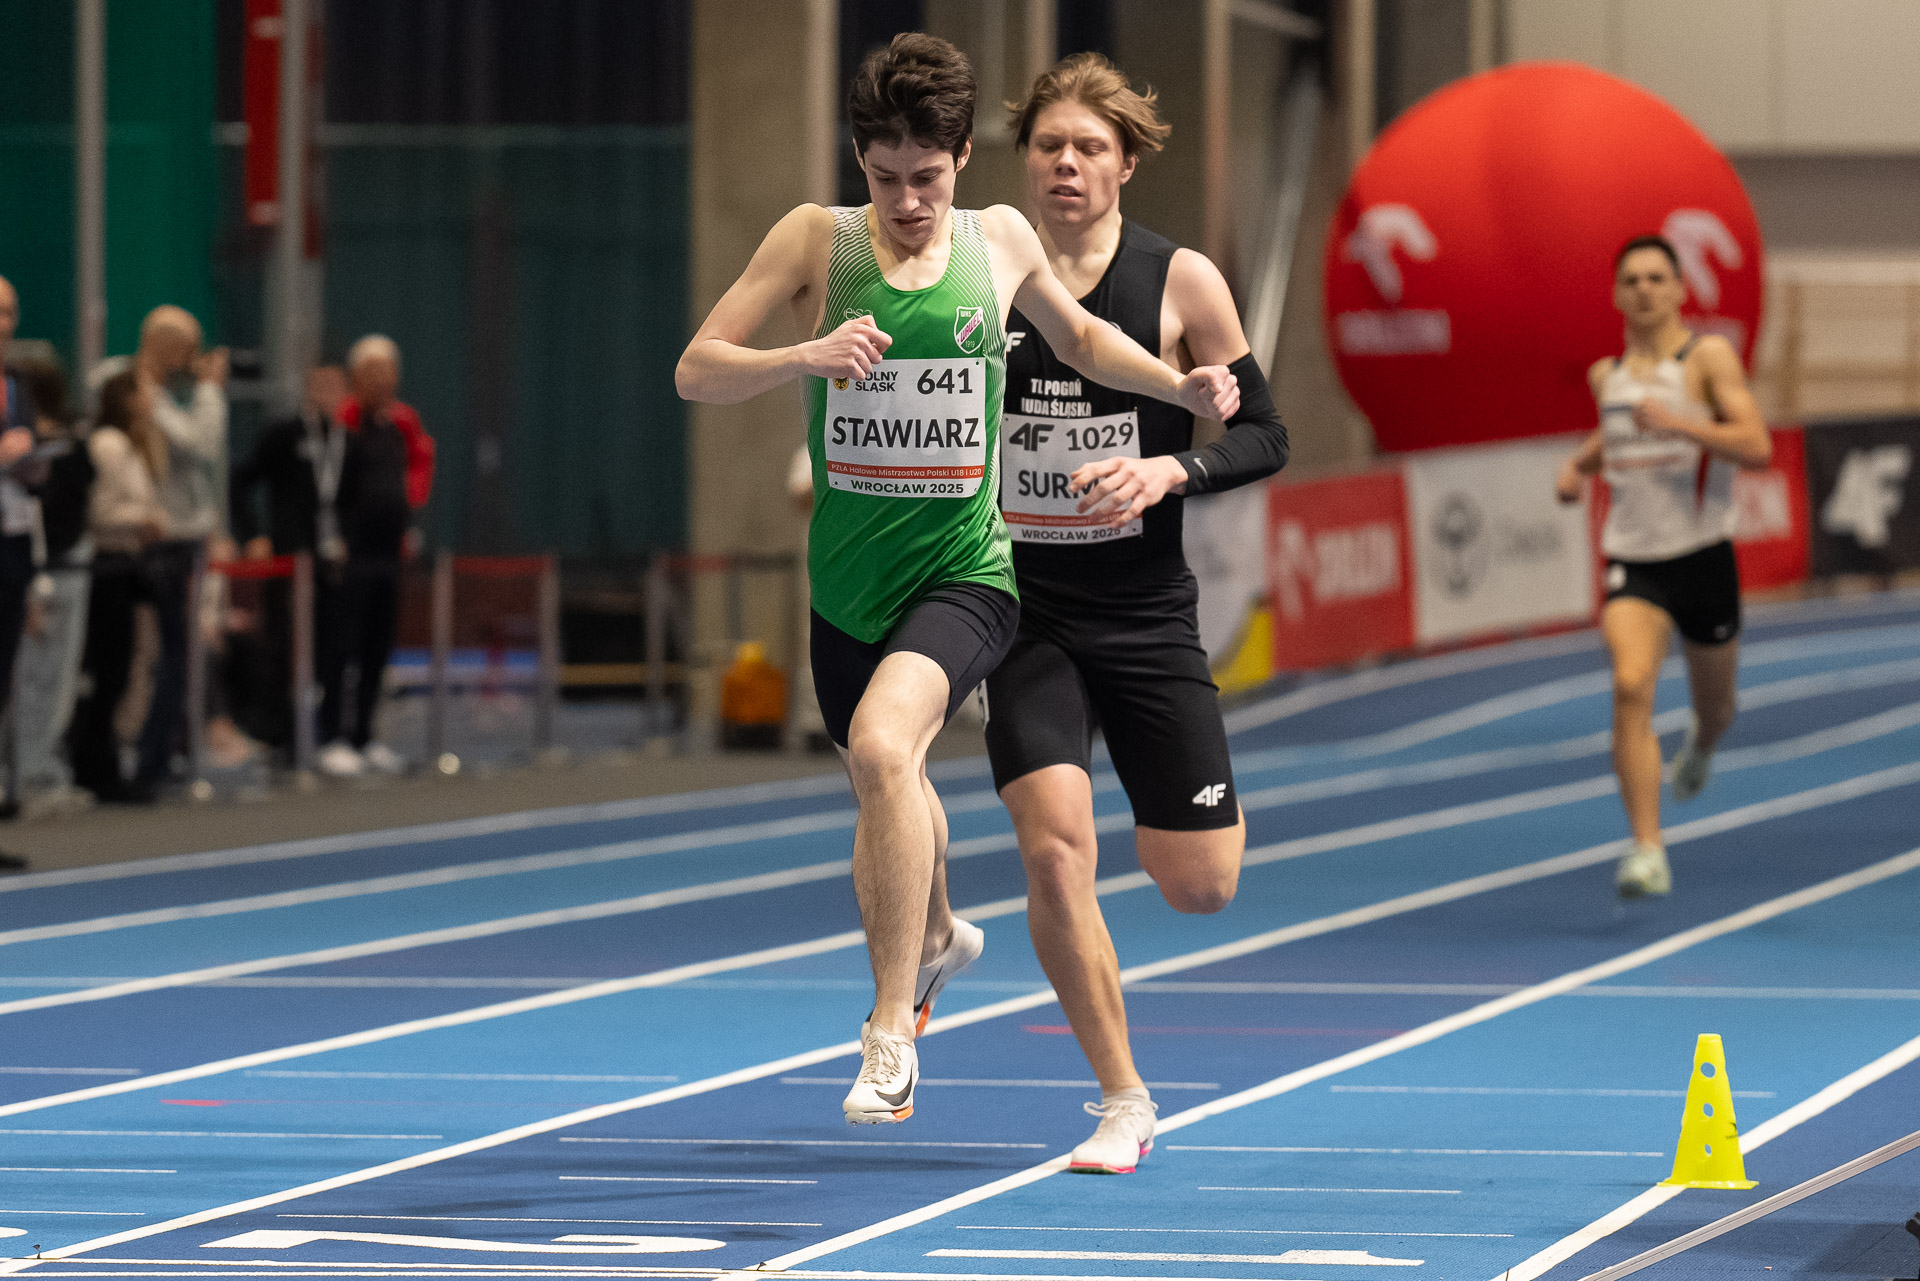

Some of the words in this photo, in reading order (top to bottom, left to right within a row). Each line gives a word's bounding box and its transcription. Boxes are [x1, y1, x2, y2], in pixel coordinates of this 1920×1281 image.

[1005, 332, 1026, 352] F
[865, 371, 899, 381] OLNY
[917, 368, 973, 395] 641
[1044, 378, 1082, 396] POGOŃ
[1050, 398, 1092, 418] ŚLĄSKA
[832, 416, 980, 448] STAWIARZ
[1009, 422, 1055, 451] 4F
[1066, 422, 1134, 451] 1029
[831, 463, 848, 473] PZLA
[849, 466, 877, 476] Halowe
[878, 469, 925, 477] Mistrzostwa
[951, 469, 965, 477] U18
[969, 468, 982, 476] U20
[851, 479, 926, 494] WROCŁAW
[929, 483, 964, 494] 2025
[1021, 528, 1088, 540] WROCŁAW
[1092, 528, 1121, 539] 2025
[1192, 783, 1226, 807] 4F
